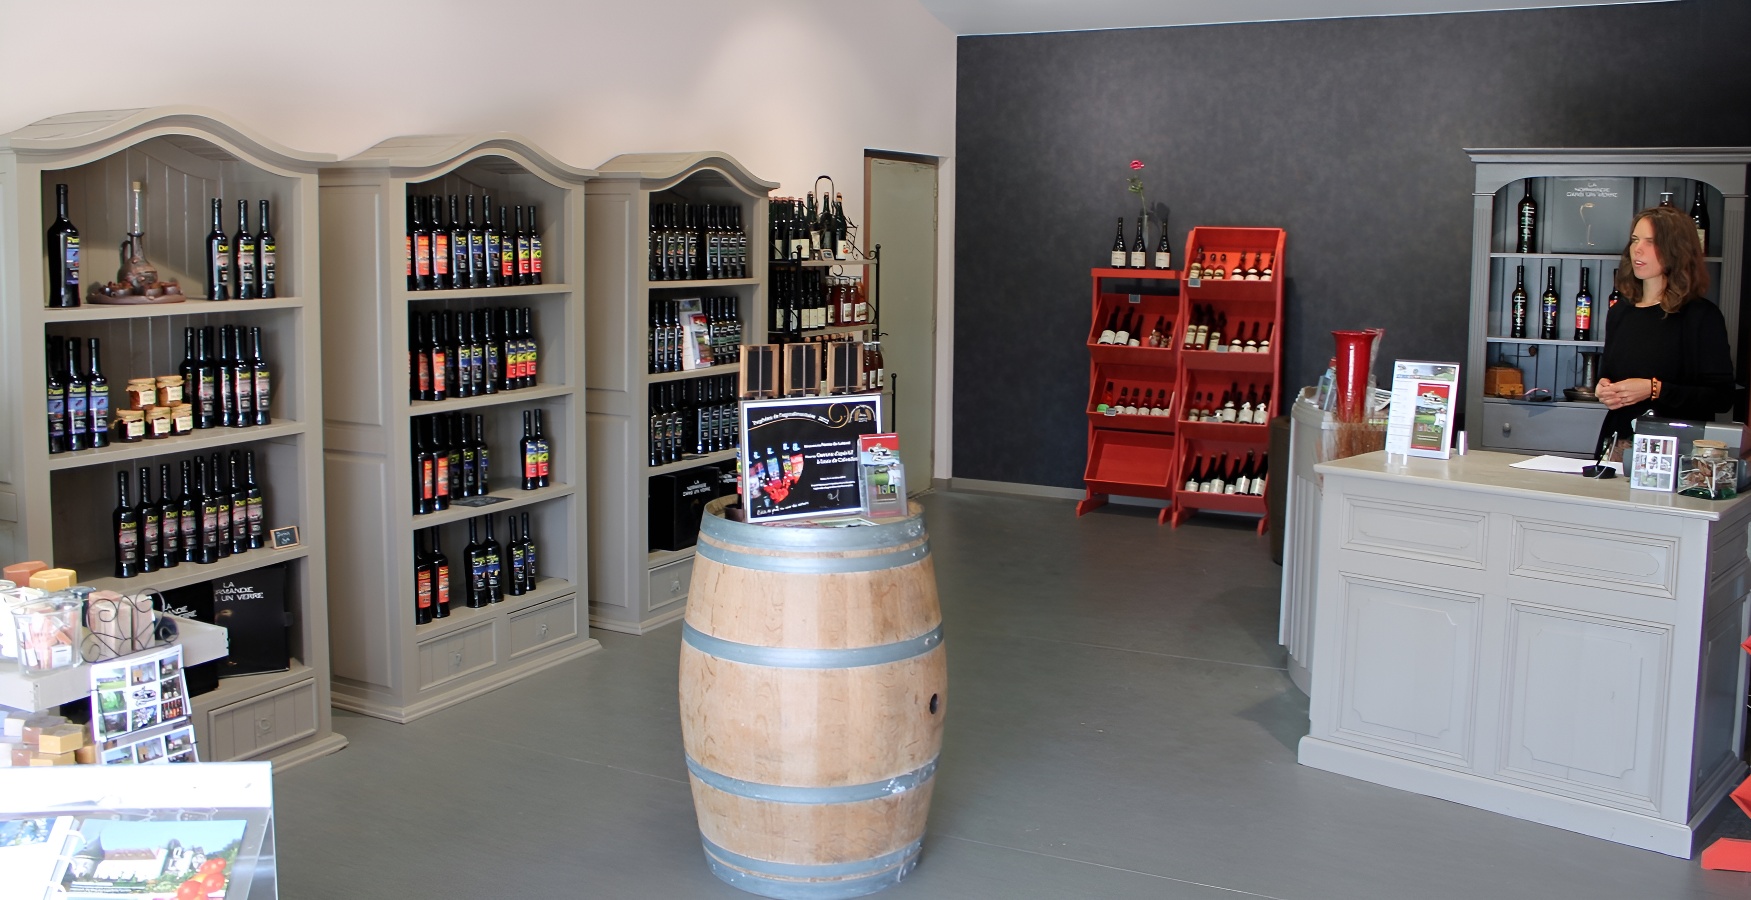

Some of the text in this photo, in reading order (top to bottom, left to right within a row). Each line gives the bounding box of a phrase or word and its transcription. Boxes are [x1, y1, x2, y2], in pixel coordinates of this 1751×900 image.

[223, 581, 235, 589] LA
[221, 592, 264, 602] UN VERRE
